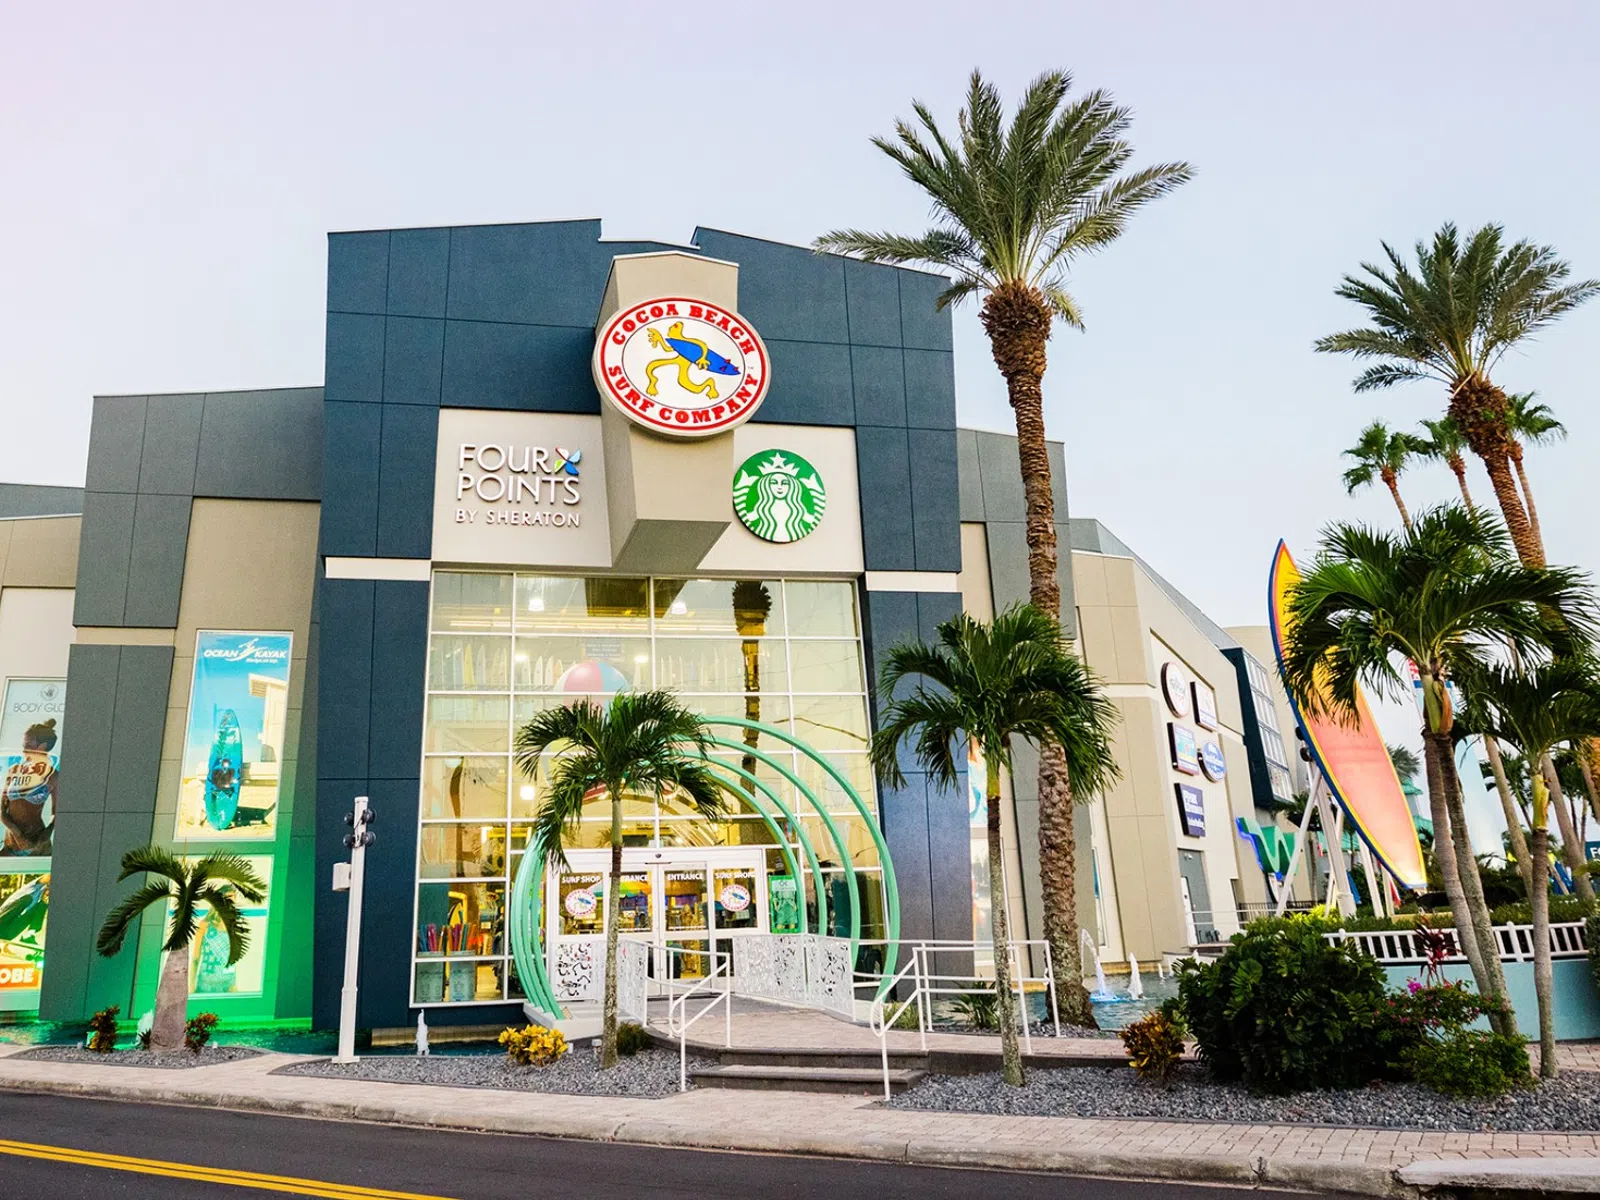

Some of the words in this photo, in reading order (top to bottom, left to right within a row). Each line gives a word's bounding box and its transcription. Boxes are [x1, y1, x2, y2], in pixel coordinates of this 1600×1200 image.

[611, 303, 680, 346] COCOA
[688, 304, 756, 355] BEACH
[607, 365, 656, 413] SURF
[658, 373, 759, 424] COMPANY
[458, 444, 552, 474] FOUR
[457, 473, 581, 505] POINTS
[455, 508, 478, 524] BY
[486, 509, 580, 528] SHERATON
[203, 649, 239, 658] OCEAN
[254, 650, 287, 659] KAYAK
[13, 702, 42, 713] BODY
[562, 876, 580, 884] SURF
[581, 875, 601, 883] SHOP
[667, 873, 704, 881] ENTRANCE
